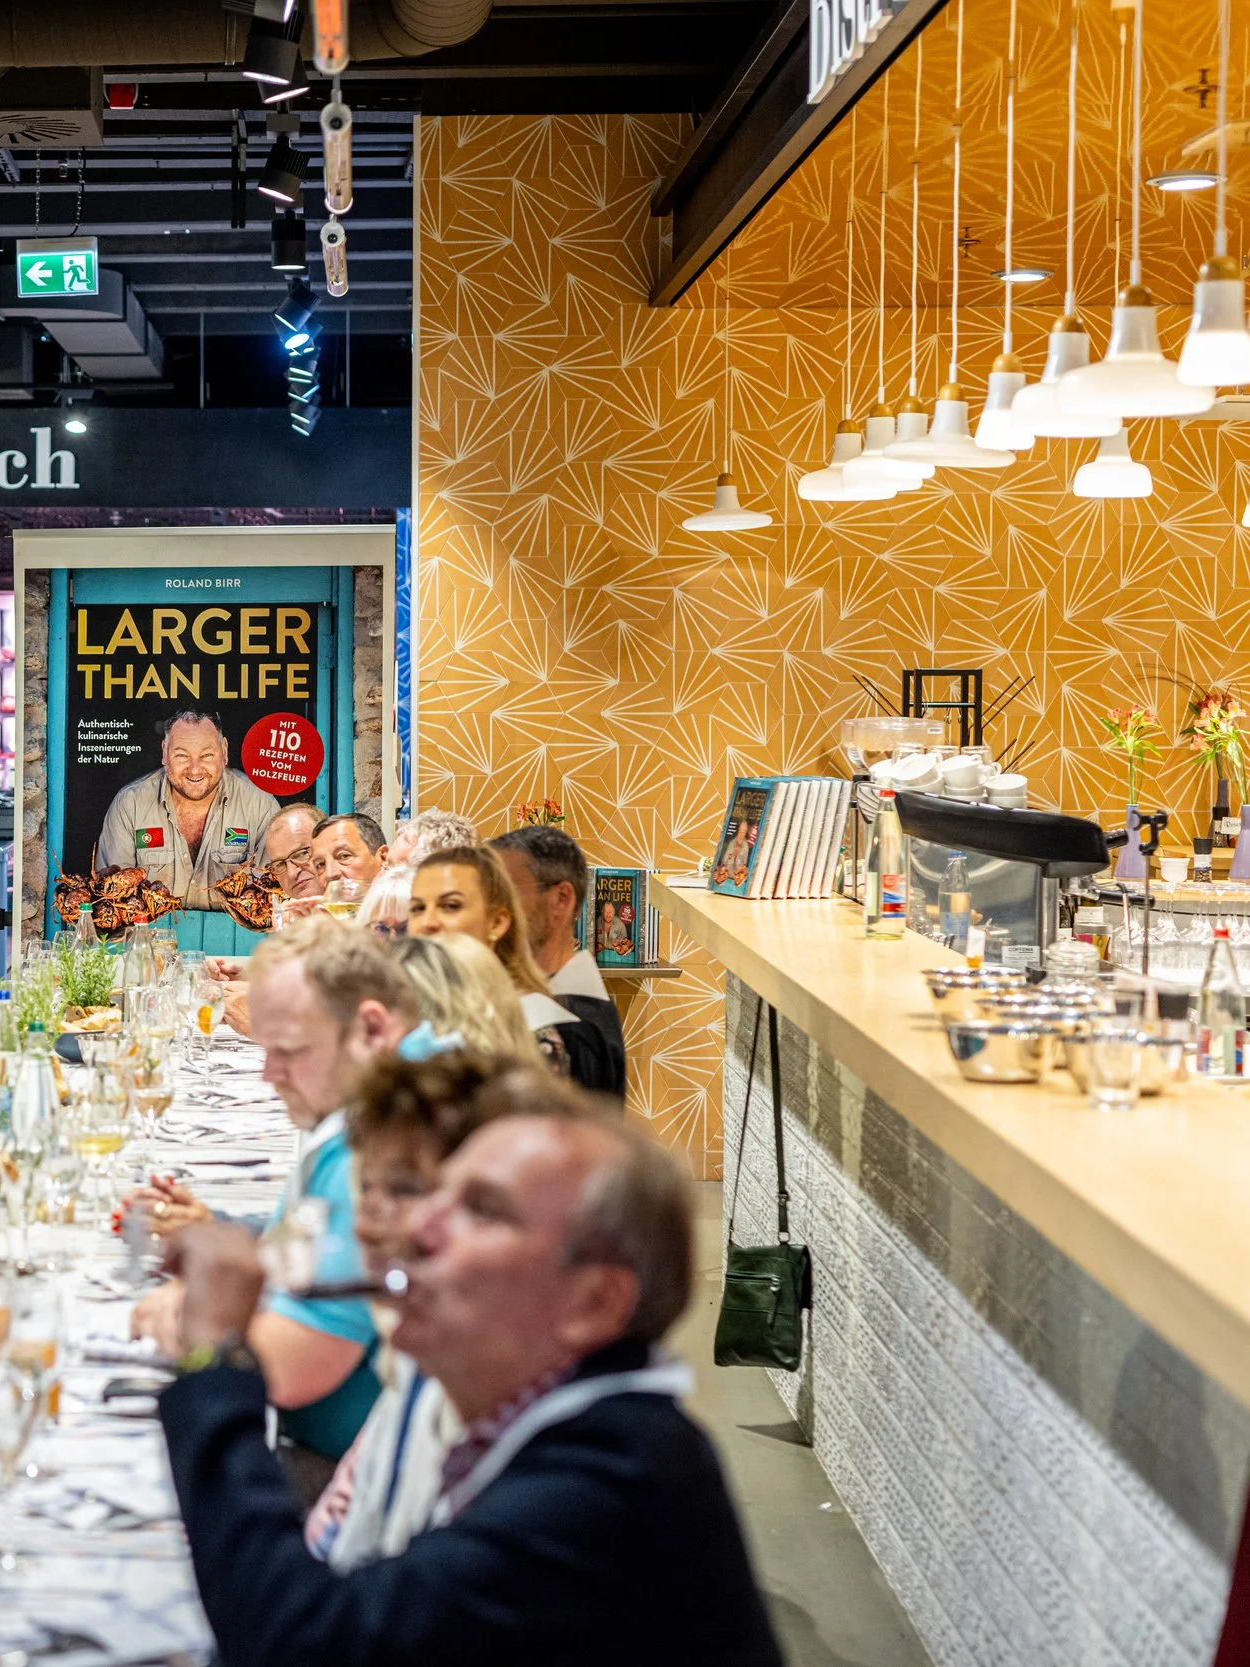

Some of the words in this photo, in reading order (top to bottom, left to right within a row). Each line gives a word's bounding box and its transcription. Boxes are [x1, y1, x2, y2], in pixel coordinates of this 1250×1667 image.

[165, 579, 212, 588] ROLAND
[215, 578, 241, 588] BIRR
[77, 607, 311, 655] LARGER
[77, 663, 200, 699] THAN
[217, 663, 310, 699] LIFE
[77, 718, 134, 728] Authentisch-
[279, 720, 296, 730] MIT
[77, 730, 129, 740] kulinarische
[270, 728, 301, 751] 110
[77, 742, 142, 755] Inszenierungen
[77, 754, 92, 763] der
[94, 754, 120, 763] Natur
[259, 748, 306, 763] REZEPTEN
[270, 760, 292, 771] VOM
[251, 767, 307, 784] HOLZFEUER
[612, 892, 631, 902] LIFE
